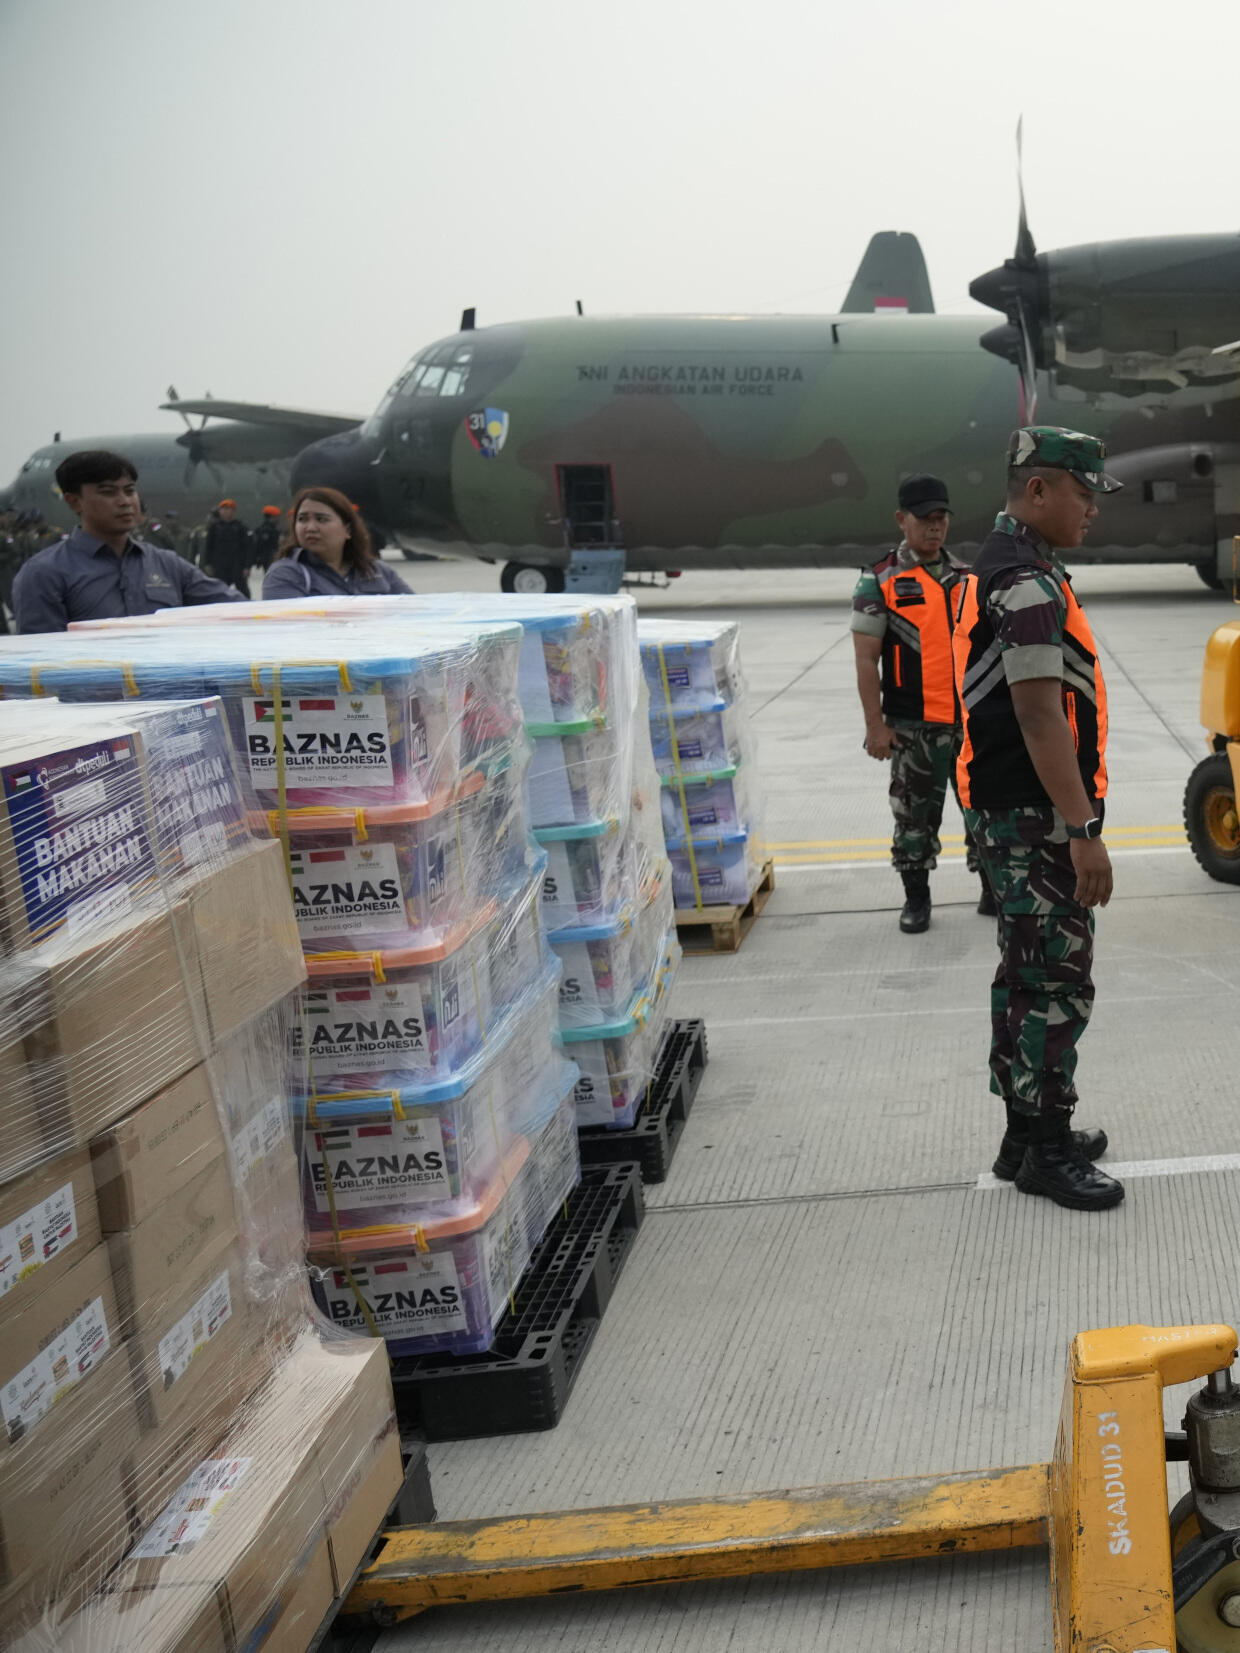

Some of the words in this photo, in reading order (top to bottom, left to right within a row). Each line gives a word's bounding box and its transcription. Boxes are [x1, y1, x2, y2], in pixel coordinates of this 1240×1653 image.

[618, 365, 726, 382] ANGKATAN
[734, 366, 804, 383] UDARA
[612, 384, 696, 395] INDONESIAN
[701, 384, 724, 395] AIR
[728, 384, 776, 396] FORCE
[469, 413, 485, 430] 31
[248, 732, 387, 756] BAZNAS
[251, 756, 314, 767] REPBLIK
[318, 755, 387, 765] INDONESIA
[33, 803, 136, 868] BANTUAN
[36, 835, 142, 903] MAKANAN
[292, 879, 399, 907] AZNAS
[332, 901, 401, 914] INDONESIA
[355, 1039, 423, 1052] INDONESIA
[311, 1151, 443, 1183] BAZNAS
[377, 1171, 444, 1185] INDONESIA
[334, 1312, 393, 1328] REPULIK
[395, 1304, 460, 1319] INDONESIA
[1097, 1410, 1121, 1437] 31
[1100, 1443, 1132, 1555] SKADUD
